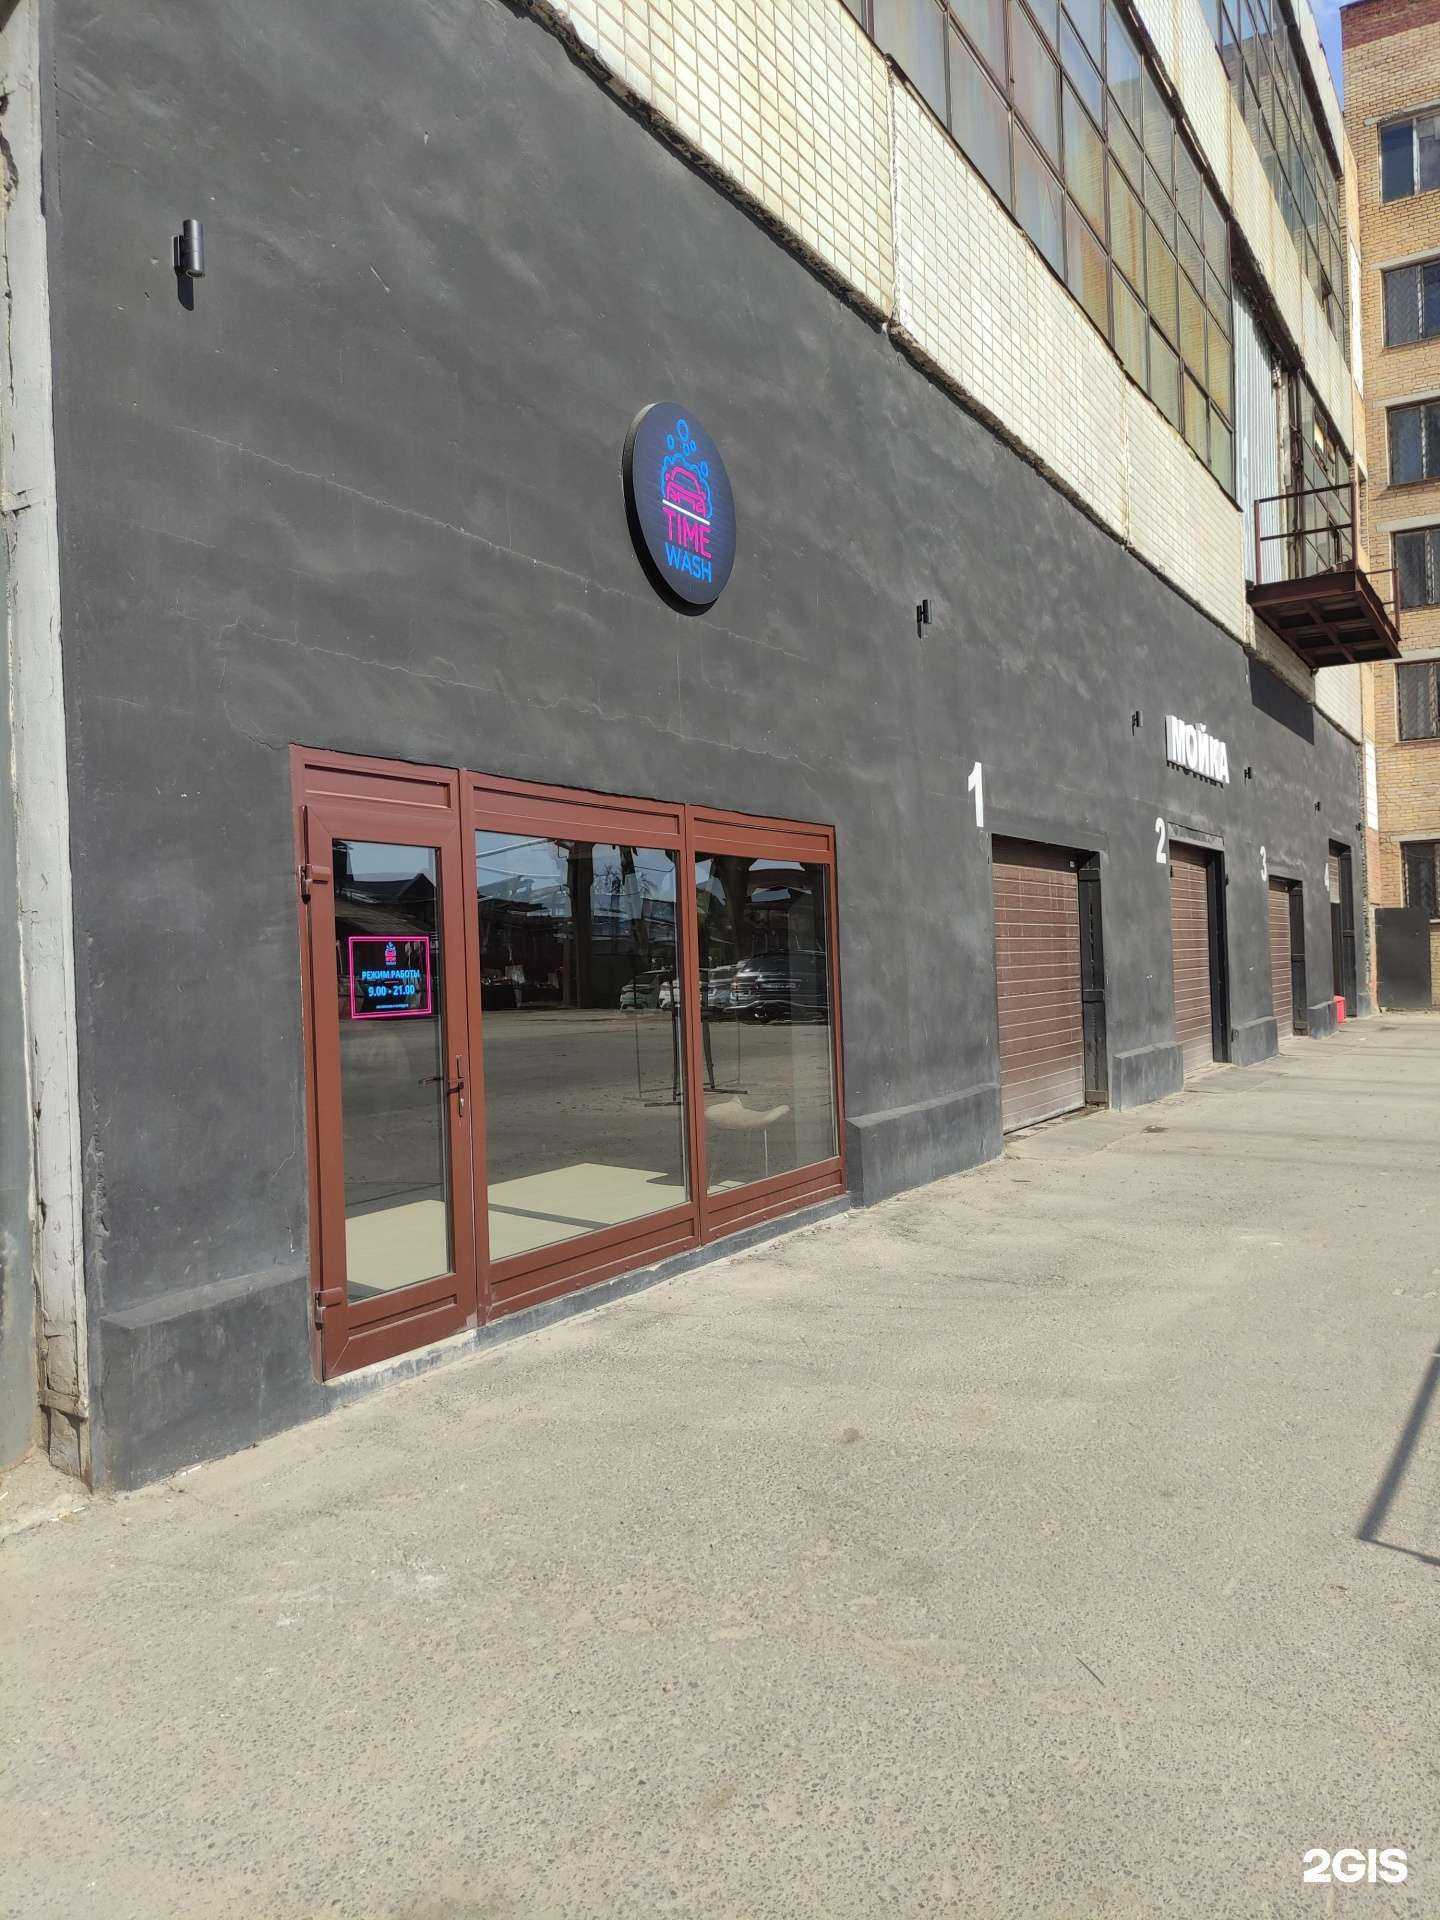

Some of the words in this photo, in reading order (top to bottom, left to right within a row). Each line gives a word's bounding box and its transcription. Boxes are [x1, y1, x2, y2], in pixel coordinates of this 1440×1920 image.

[662, 507, 712, 559] TIME
[665, 543, 712, 583] WASH
[1166, 715, 1230, 784] МОЙКА
[967, 762, 984, 828] 1
[1155, 817, 1167, 864] 2
[1260, 846, 1268, 882] 3
[362, 971, 390, 980] РЕЖИМ
[391, 969, 420, 978] РАБОТЫ
[368, 986, 387, 997] 9.00
[393, 984, 415, 996] 21.00
